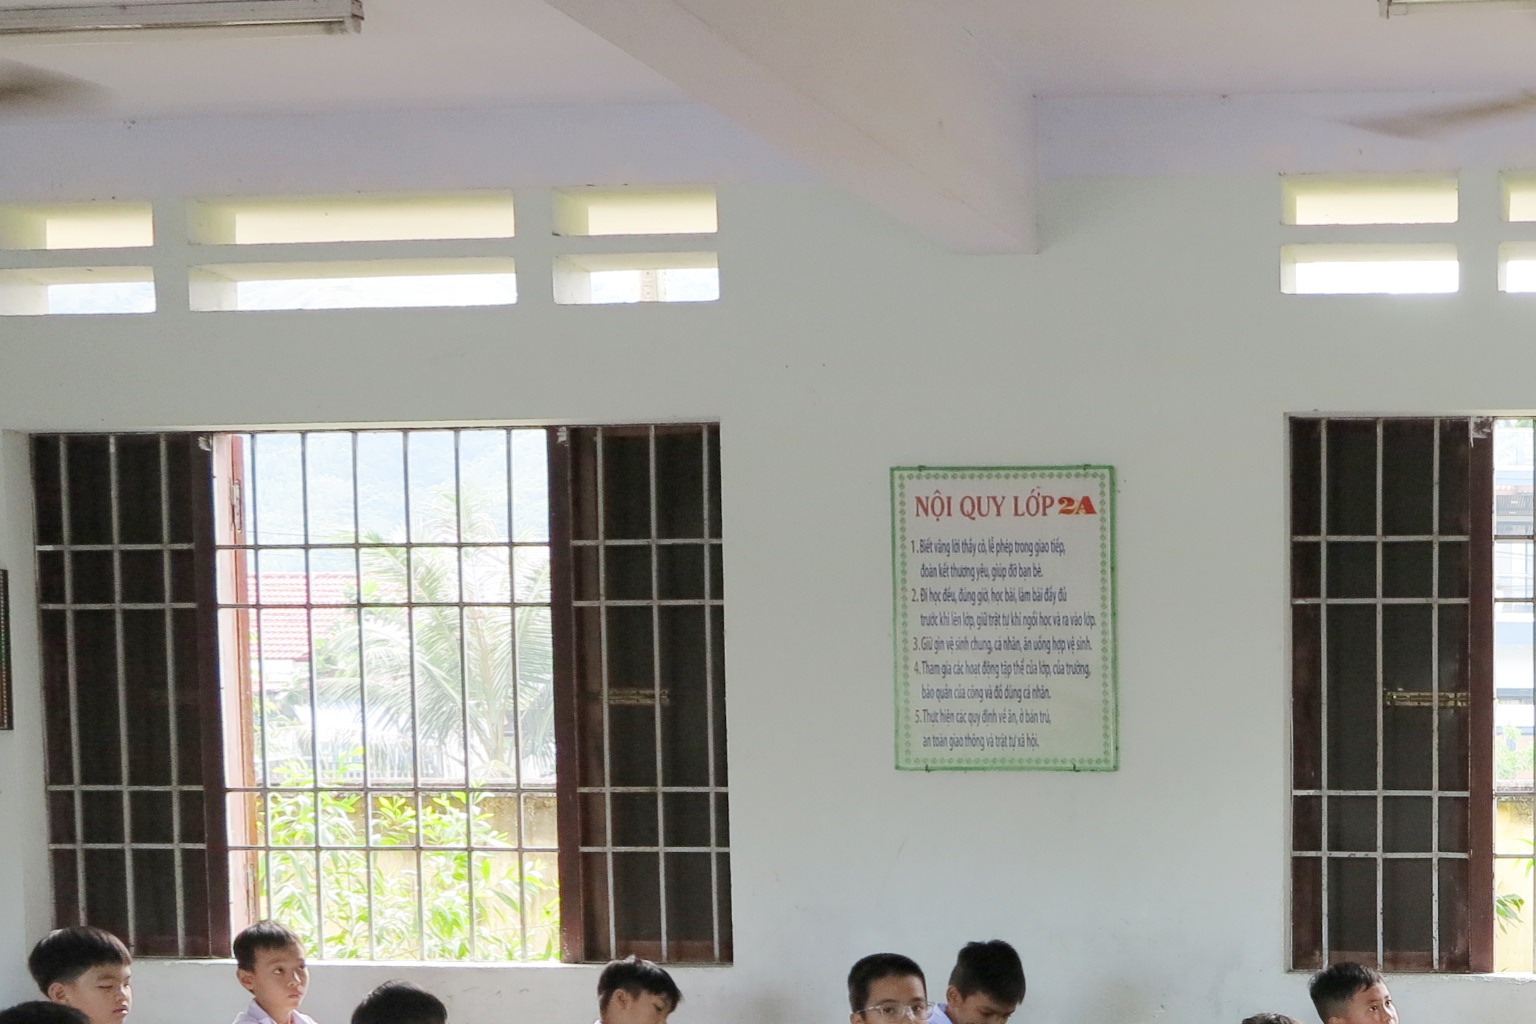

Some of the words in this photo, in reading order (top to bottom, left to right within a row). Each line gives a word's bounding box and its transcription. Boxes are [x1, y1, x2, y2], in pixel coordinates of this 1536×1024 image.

[915, 489, 952, 522] NỘI
[960, 495, 1006, 521] QUY
[1013, 488, 1055, 517] LỚP
[1058, 495, 1097, 516] 2A
